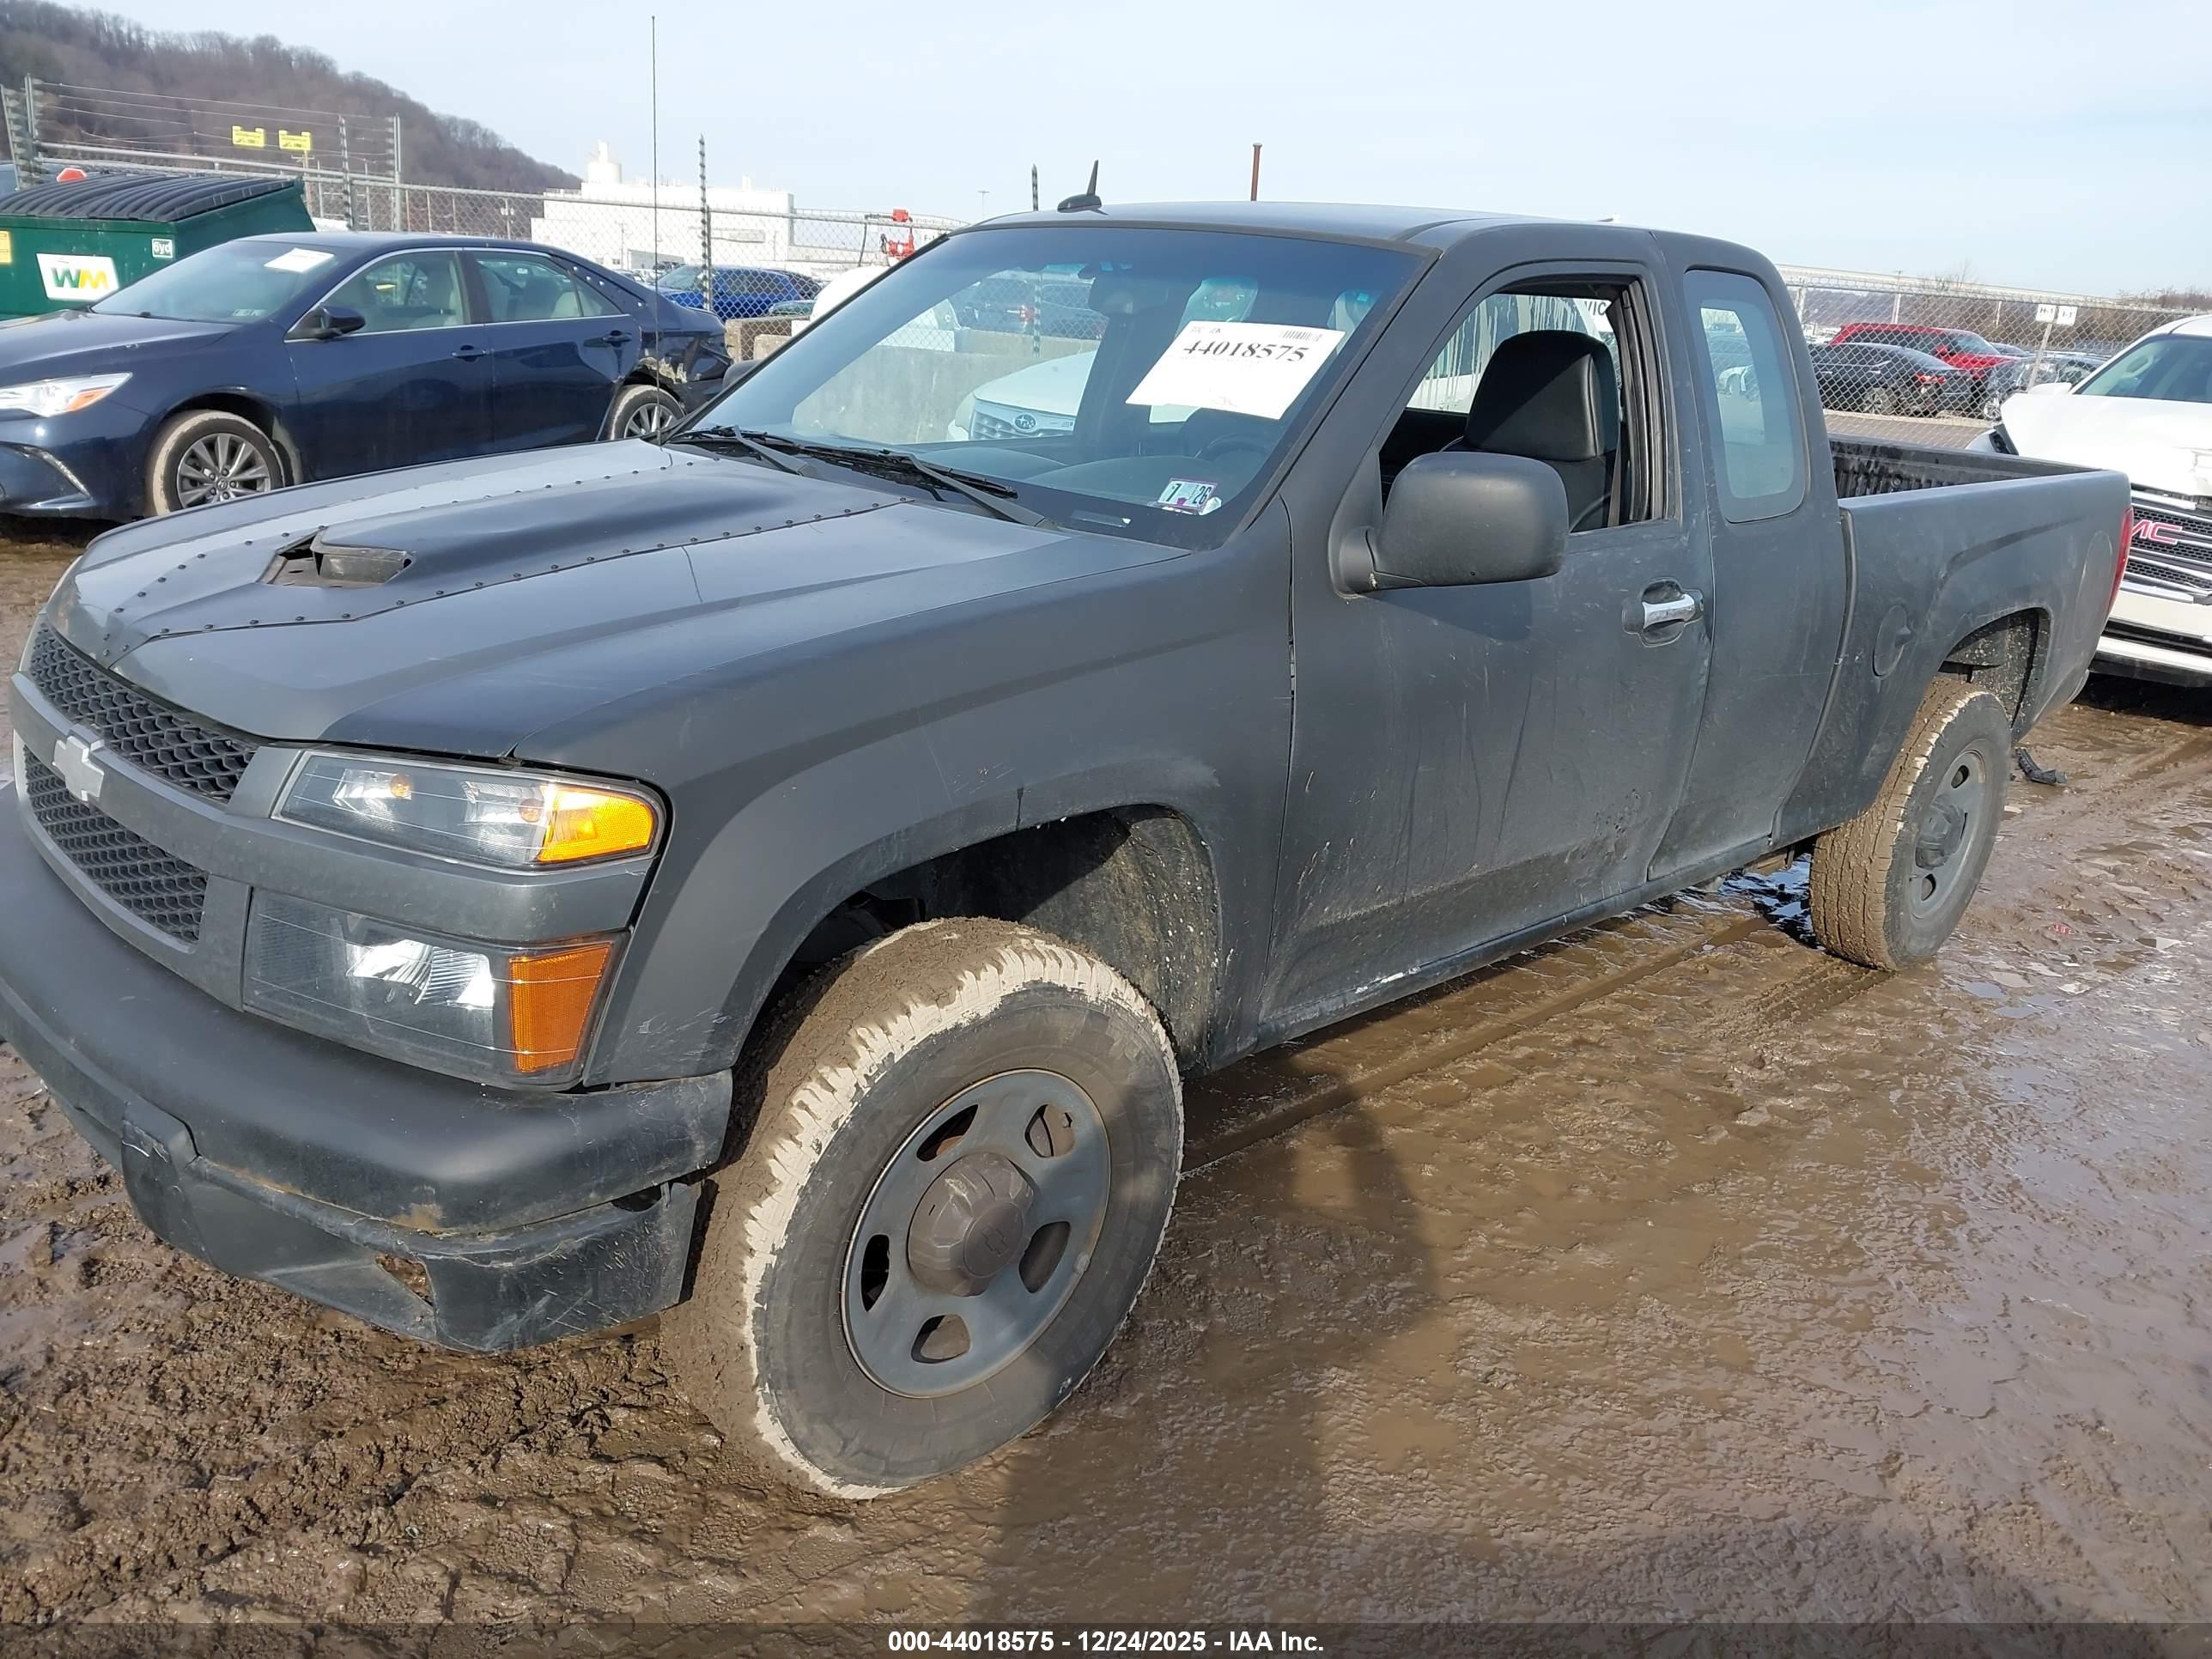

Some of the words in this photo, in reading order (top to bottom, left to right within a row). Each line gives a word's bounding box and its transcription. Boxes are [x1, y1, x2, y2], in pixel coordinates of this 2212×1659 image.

[51, 267, 109, 289] WM
[1183, 340, 1310, 362] 44018575
[1164, 483, 1182, 502] 7
[1192, 485, 1212, 505] 26
